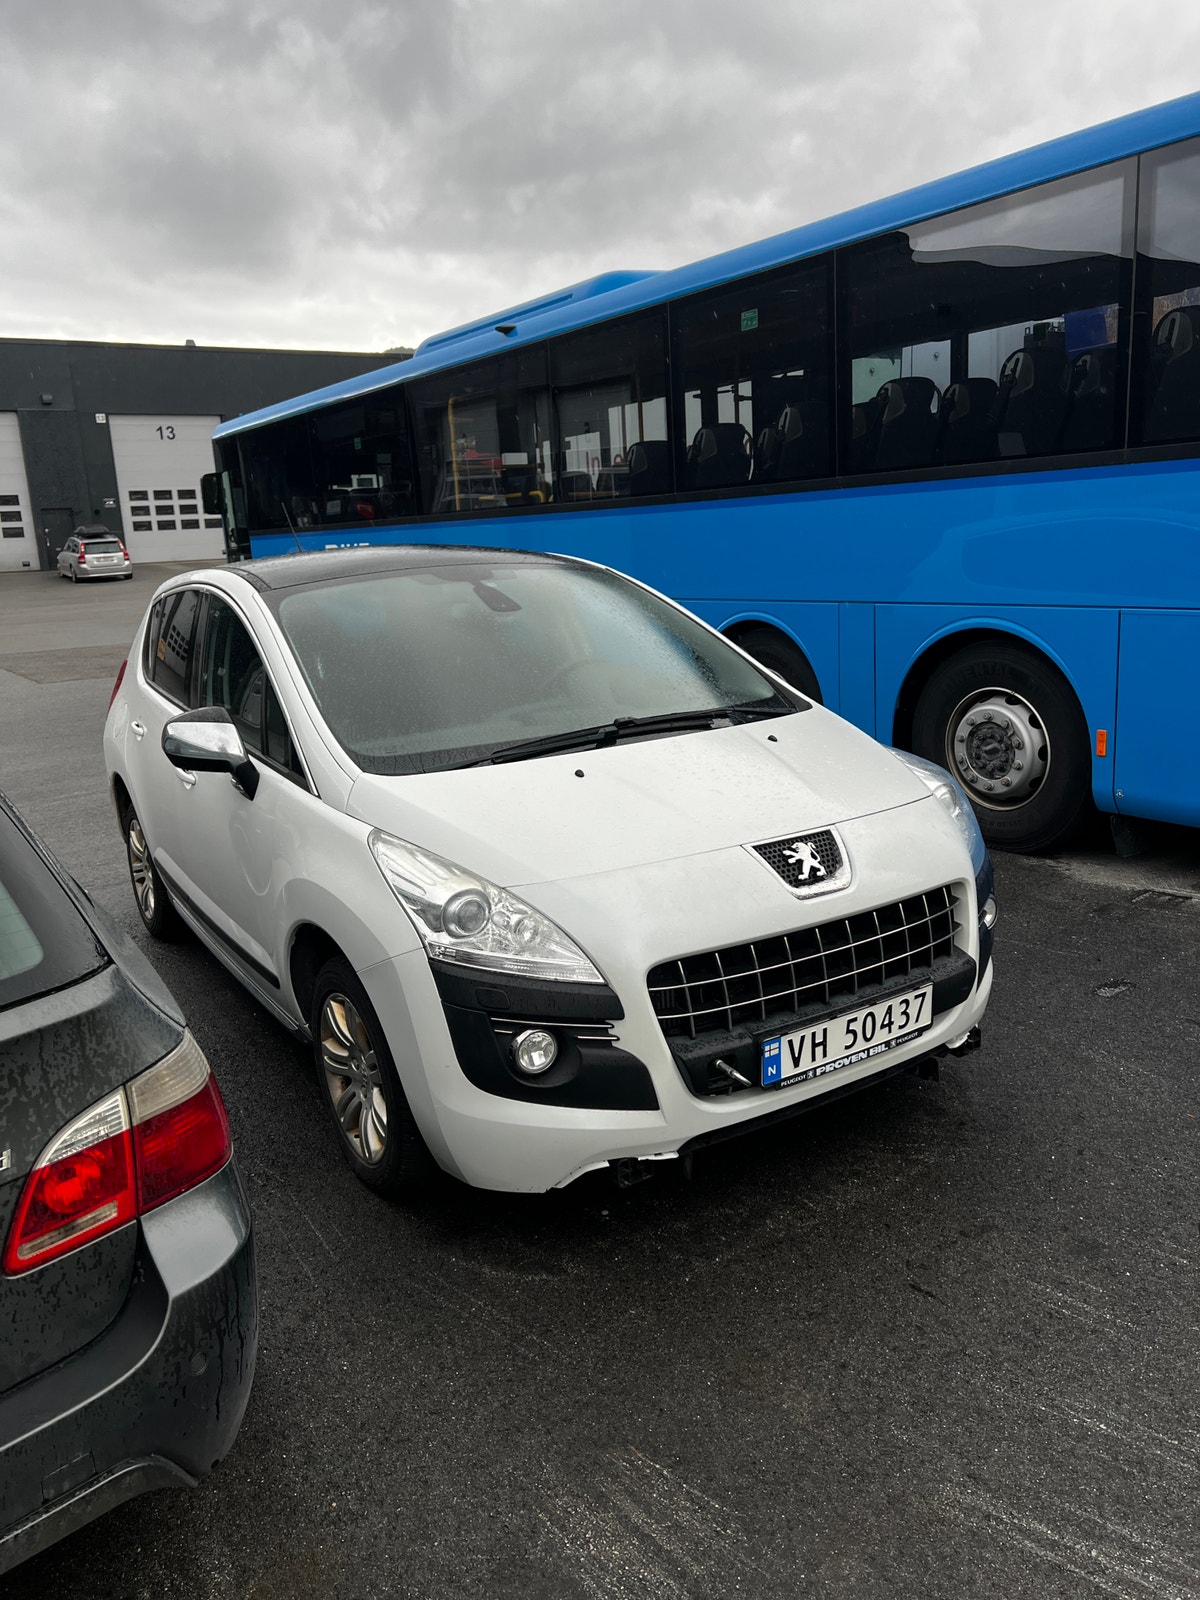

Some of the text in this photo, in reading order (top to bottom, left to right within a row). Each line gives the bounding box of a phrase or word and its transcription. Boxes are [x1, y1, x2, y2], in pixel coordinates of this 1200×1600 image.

[156, 425, 176, 440] 13
[787, 991, 927, 1069] VH 50437
[767, 1065, 777, 1076] N
[780, 1073, 807, 1087] PEUGEOT
[815, 1050, 868, 1076] PROVEN
[869, 1043, 889, 1056] BIL
